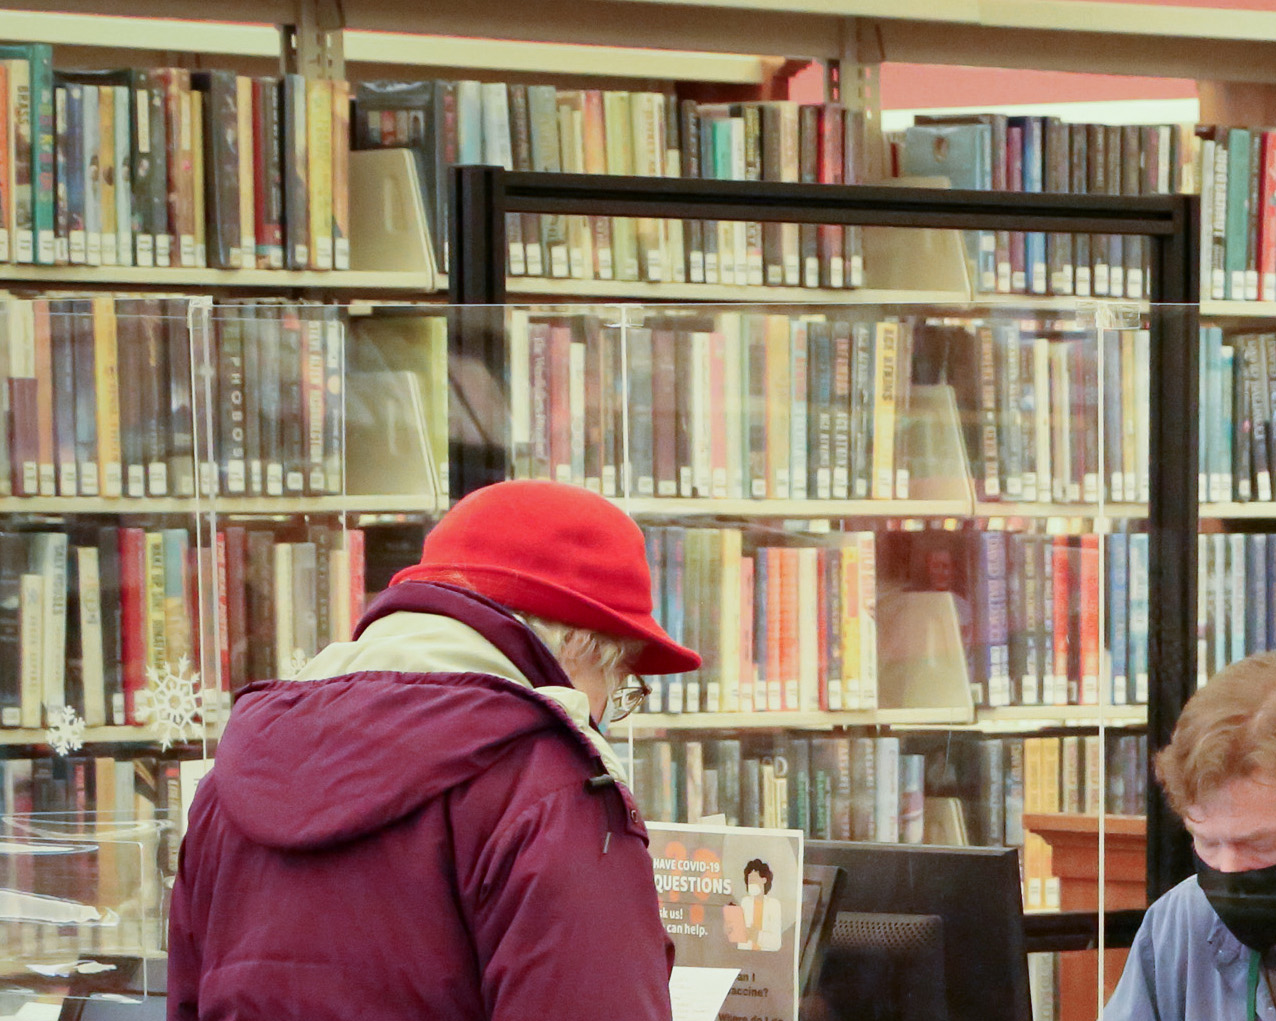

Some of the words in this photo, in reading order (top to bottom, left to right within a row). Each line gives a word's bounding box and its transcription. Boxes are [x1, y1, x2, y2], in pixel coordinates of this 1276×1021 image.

[16, 85, 31, 125] BRASS
[230, 356, 244, 459] PHOBOS
[835, 433, 848, 467] ATKIN
[653, 858, 676, 870] HAVE
[677, 860, 720, 872] COVID-19
[654, 874, 732, 895] QUESTIONS
[659, 907, 668, 919] sk
[669, 908, 683, 920] us!
[667, 924, 683, 934] can
[684, 923, 708, 938] help.
[729, 987, 769, 998] accine?
